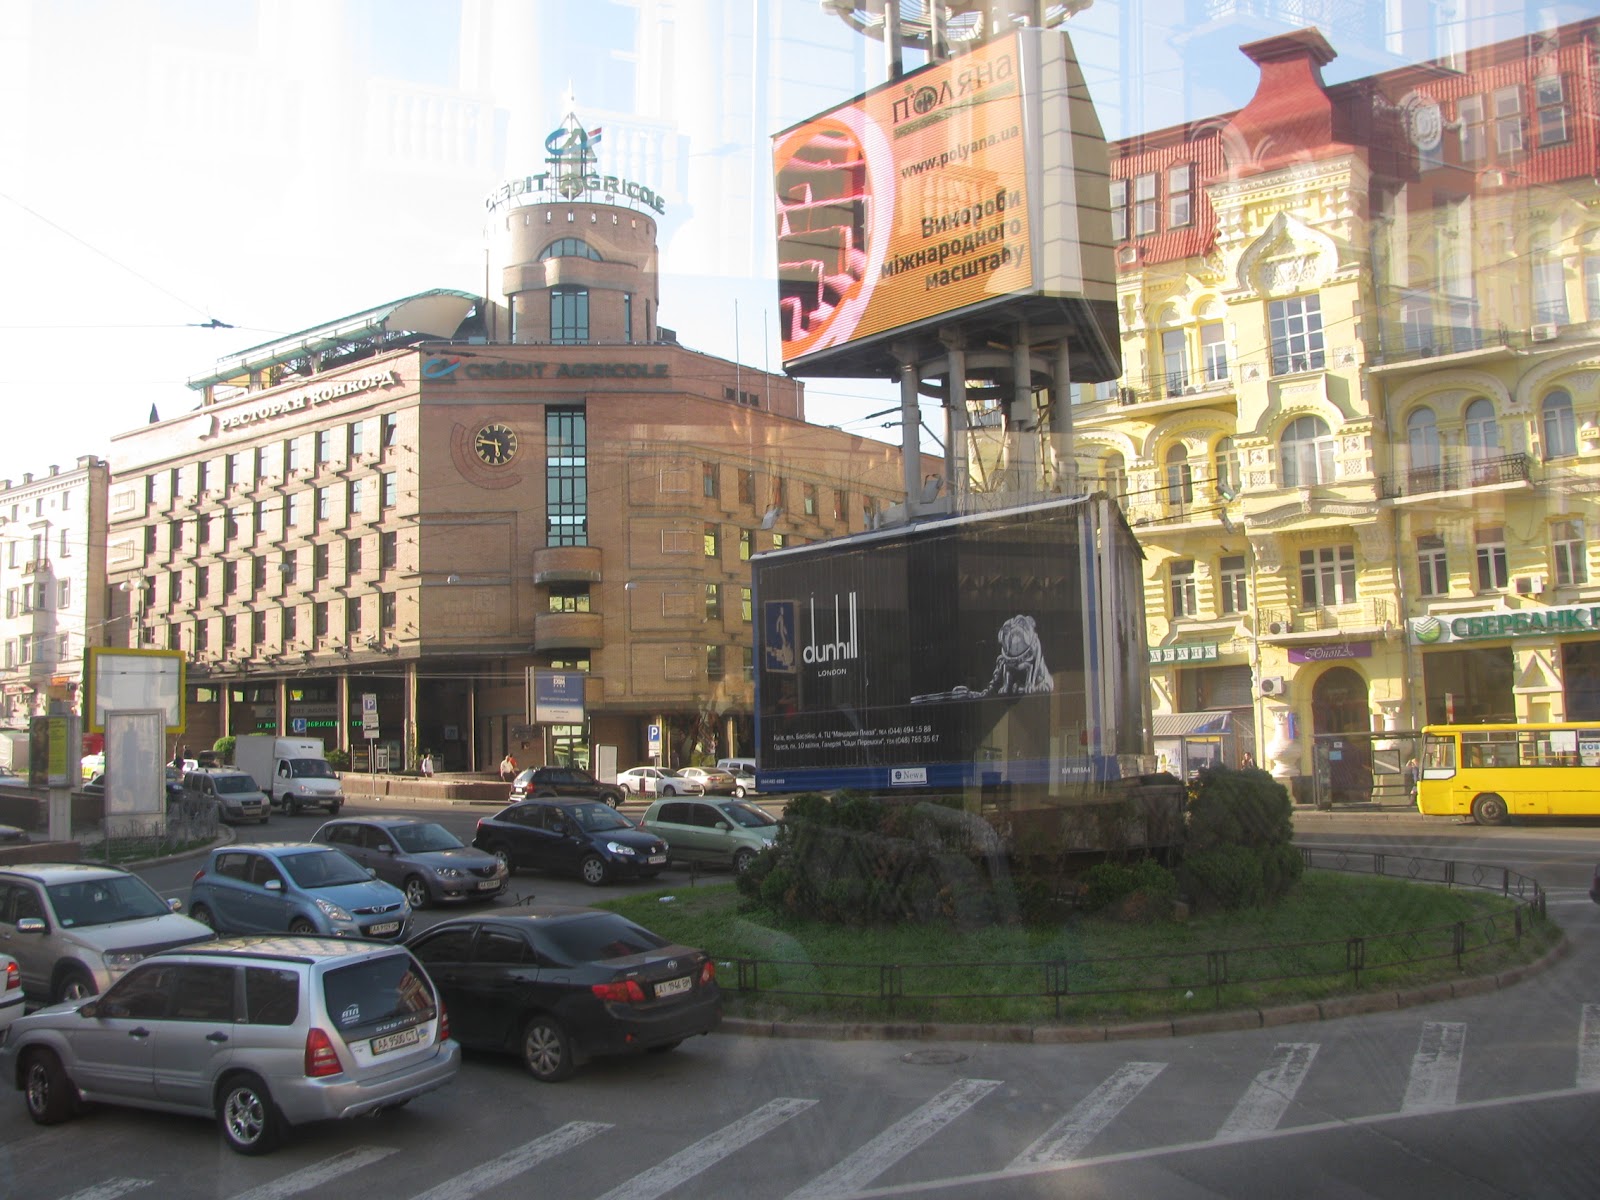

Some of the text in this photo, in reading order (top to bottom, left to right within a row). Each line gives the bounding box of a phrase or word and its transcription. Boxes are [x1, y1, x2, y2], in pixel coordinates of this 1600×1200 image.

[901, 124, 1019, 178] www.polyana.ua
[881, 219, 1020, 279] міжнародного
[925, 243, 1024, 291] масштабу
[556, 363, 669, 378] AGRICOLE
[220, 370, 395, 430] РЕСТОРАН КОНКОРД
[803, 591, 858, 663] dunhill
[1451, 609, 1587, 638] СБЕРБАНК
[817, 668, 847, 677] LONDON
[903, 771, 924, 780] News
